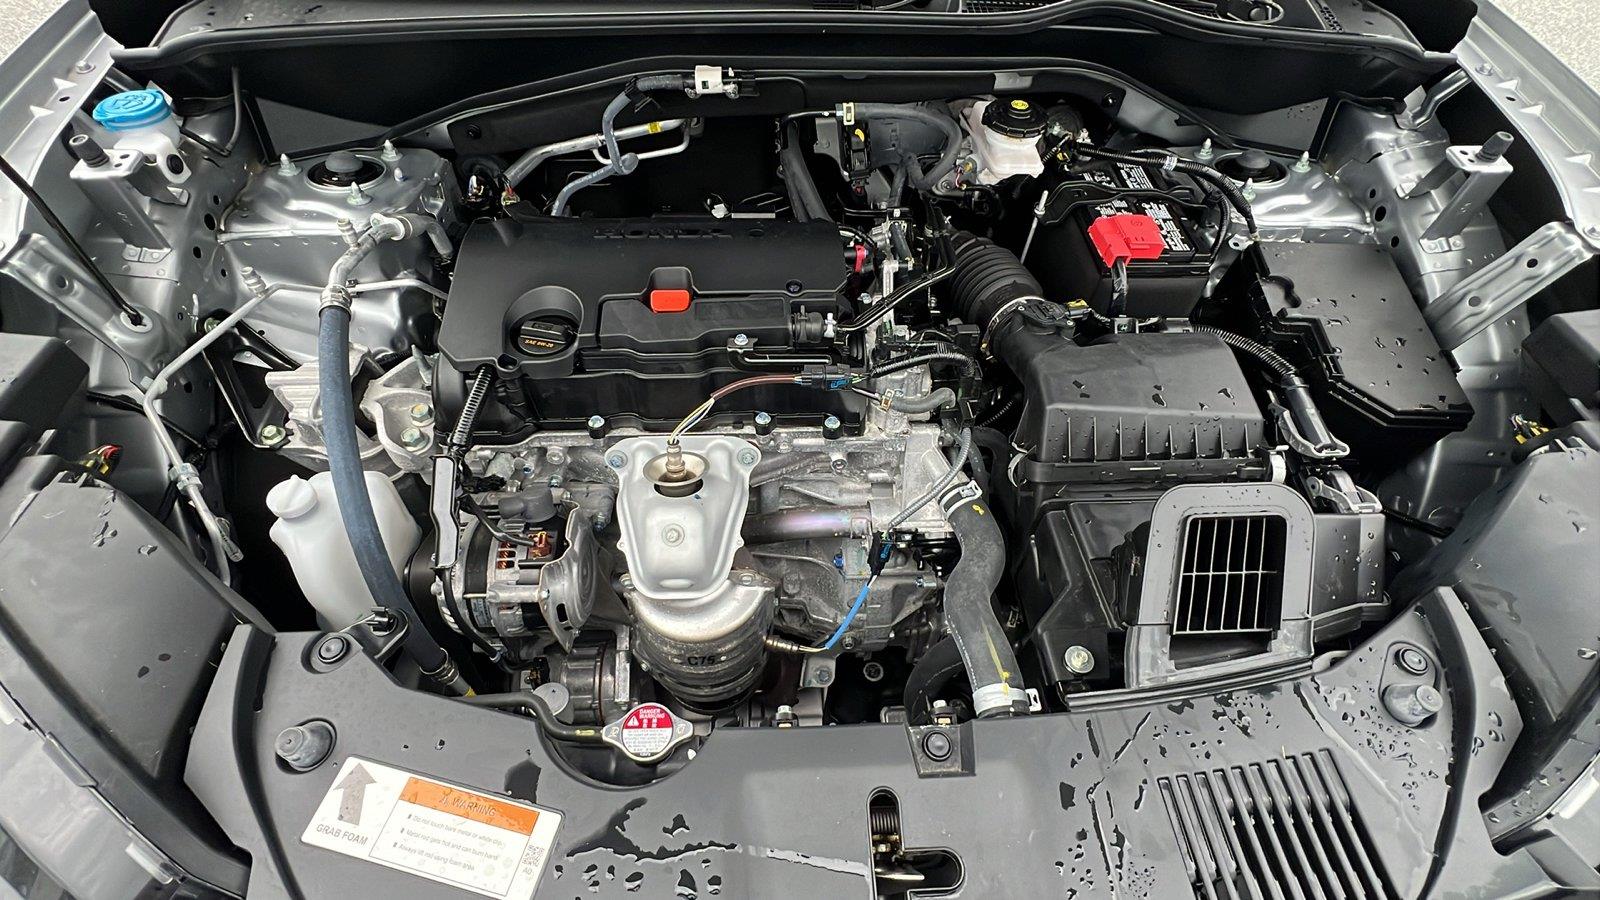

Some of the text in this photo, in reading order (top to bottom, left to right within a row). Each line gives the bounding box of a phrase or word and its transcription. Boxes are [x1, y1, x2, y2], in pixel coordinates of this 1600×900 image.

[593, 226, 733, 239] HONDA
[688, 656, 716, 665] C75
[453, 797, 497, 818] WARNING
[316, 824, 369, 846] GRAB FOAM
